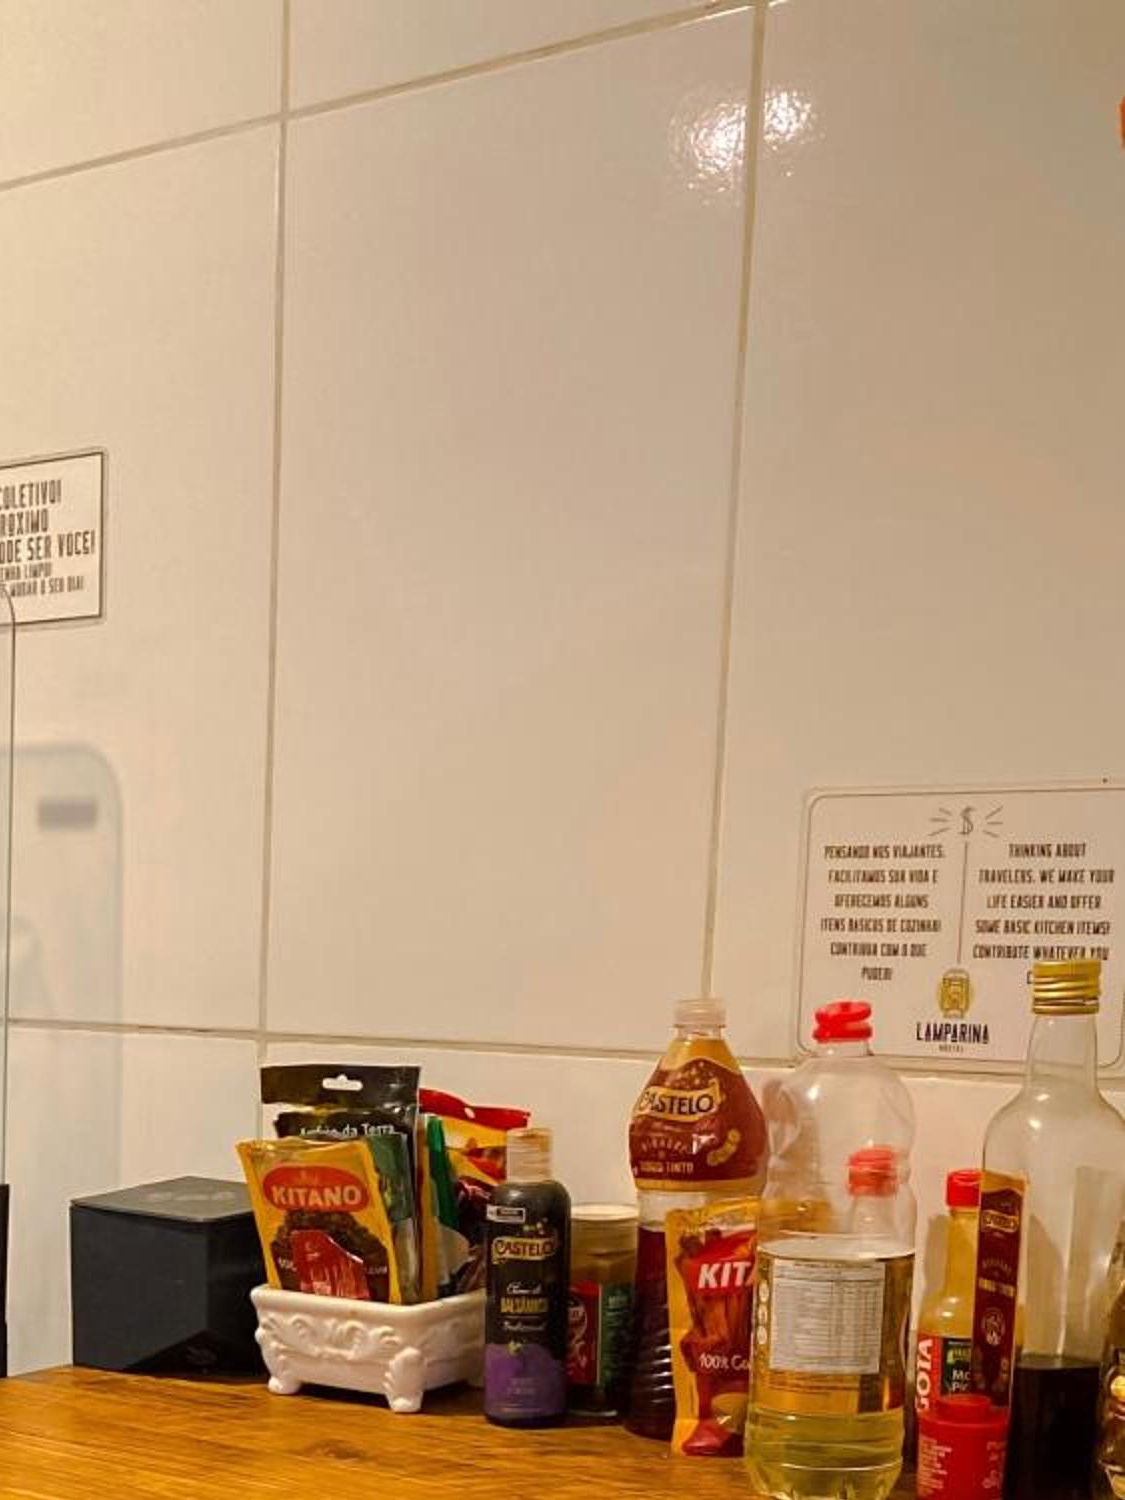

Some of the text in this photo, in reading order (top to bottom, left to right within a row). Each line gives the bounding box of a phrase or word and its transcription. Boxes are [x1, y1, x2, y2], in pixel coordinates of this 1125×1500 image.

[27, 535, 52, 561] SER
[872, 845, 890, 859] NOS
[1008, 842, 1087, 858] THINKING ABOUT
[908, 869, 930, 883] VIDA
[1038, 869, 1056, 883] WE
[1058, 869, 1086, 883] MAKE
[1088, 869, 1116, 884] YOUR
[893, 894, 930, 908] ALGUNS
[986, 894, 1103, 909] LIFE EASIER AND OFFER
[886, 918, 898, 933] DE
[975, 919, 1001, 934] SOME
[1002, 919, 1032, 934] BASIC
[1034, 920, 1074, 935] KITCHEN
[880, 943, 900, 957] COM
[972, 944, 1030, 959] CONTRIBUTE
[916, 1021, 990, 1045] LAMPARINA
[638, 1090, 714, 1116] CASTELO
[271, 1185, 362, 1207] KITANO
[493, 1237, 554, 1257] CASTELO
